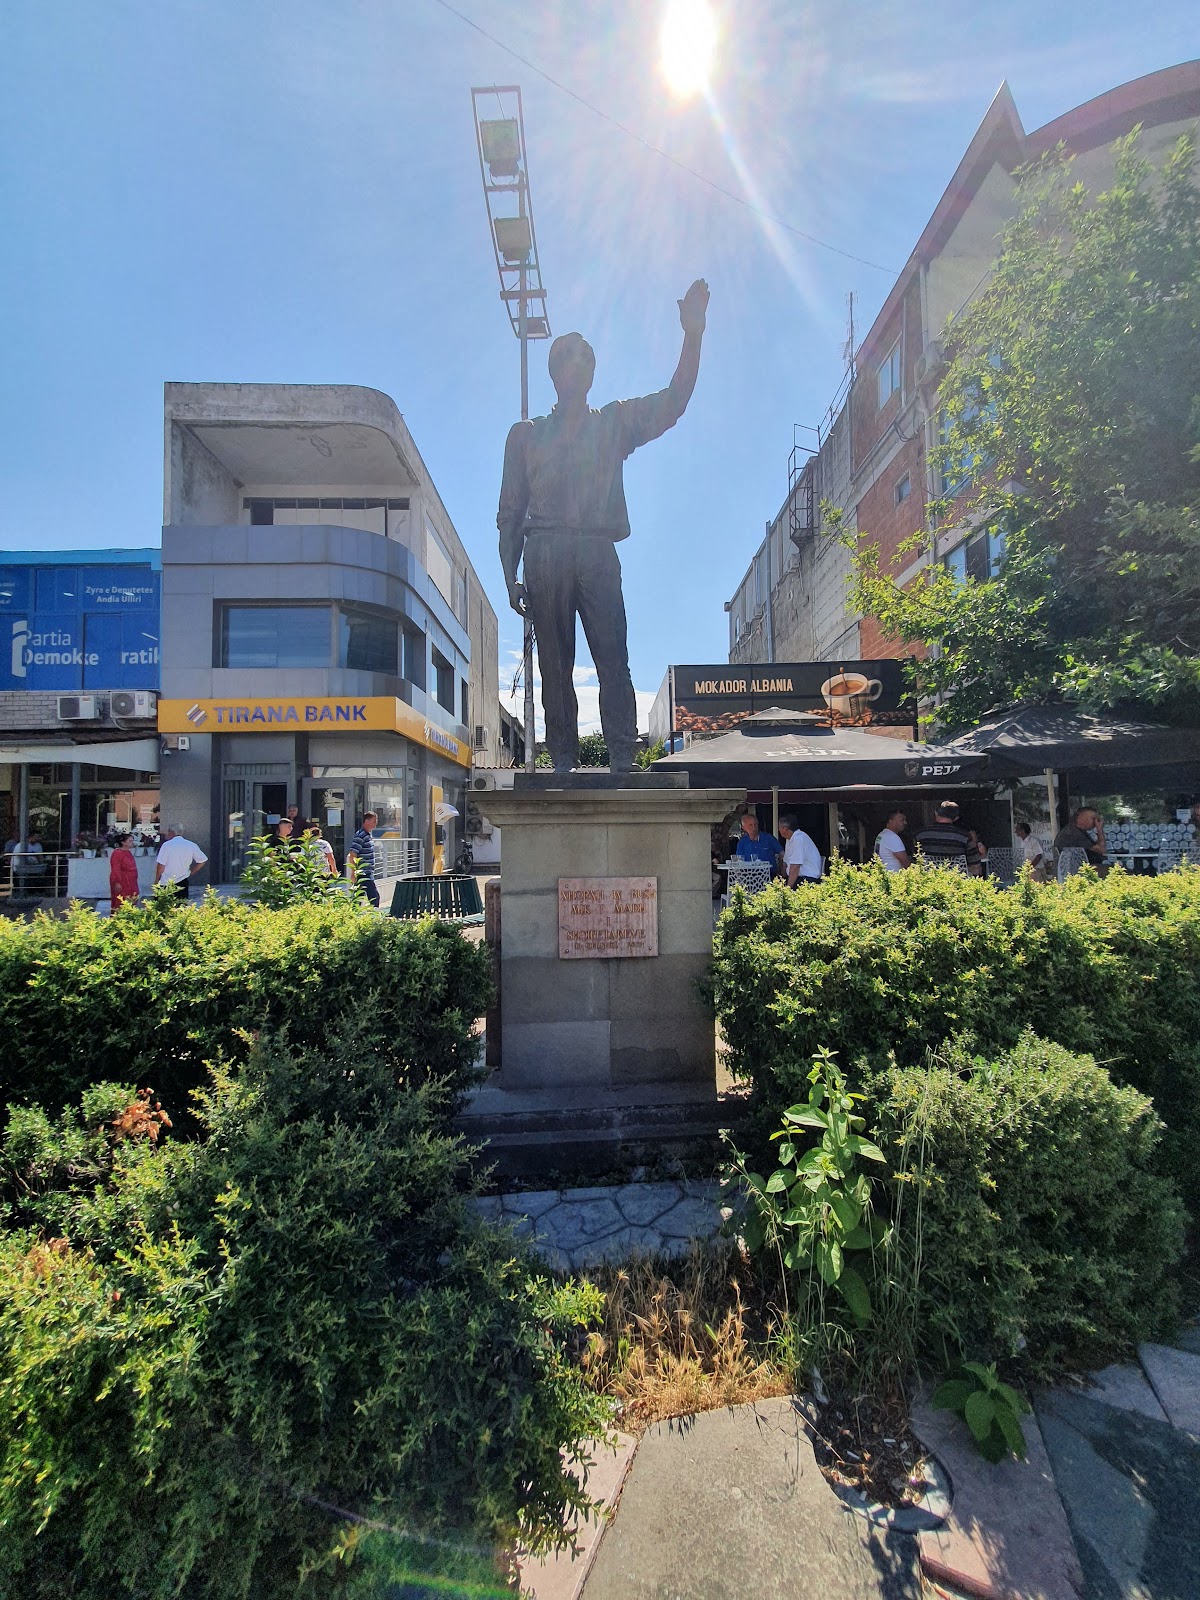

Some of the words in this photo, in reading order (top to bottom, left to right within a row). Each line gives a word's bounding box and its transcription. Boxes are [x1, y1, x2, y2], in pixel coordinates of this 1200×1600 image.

[85, 586, 104, 595] Zyra
[121, 595, 142, 603] Ulliri
[694, 679, 747, 695] MOKADOR
[750, 678, 794, 693] ALBANIA
[213, 705, 299, 723] TIRANA
[304, 704, 367, 722] BANK
